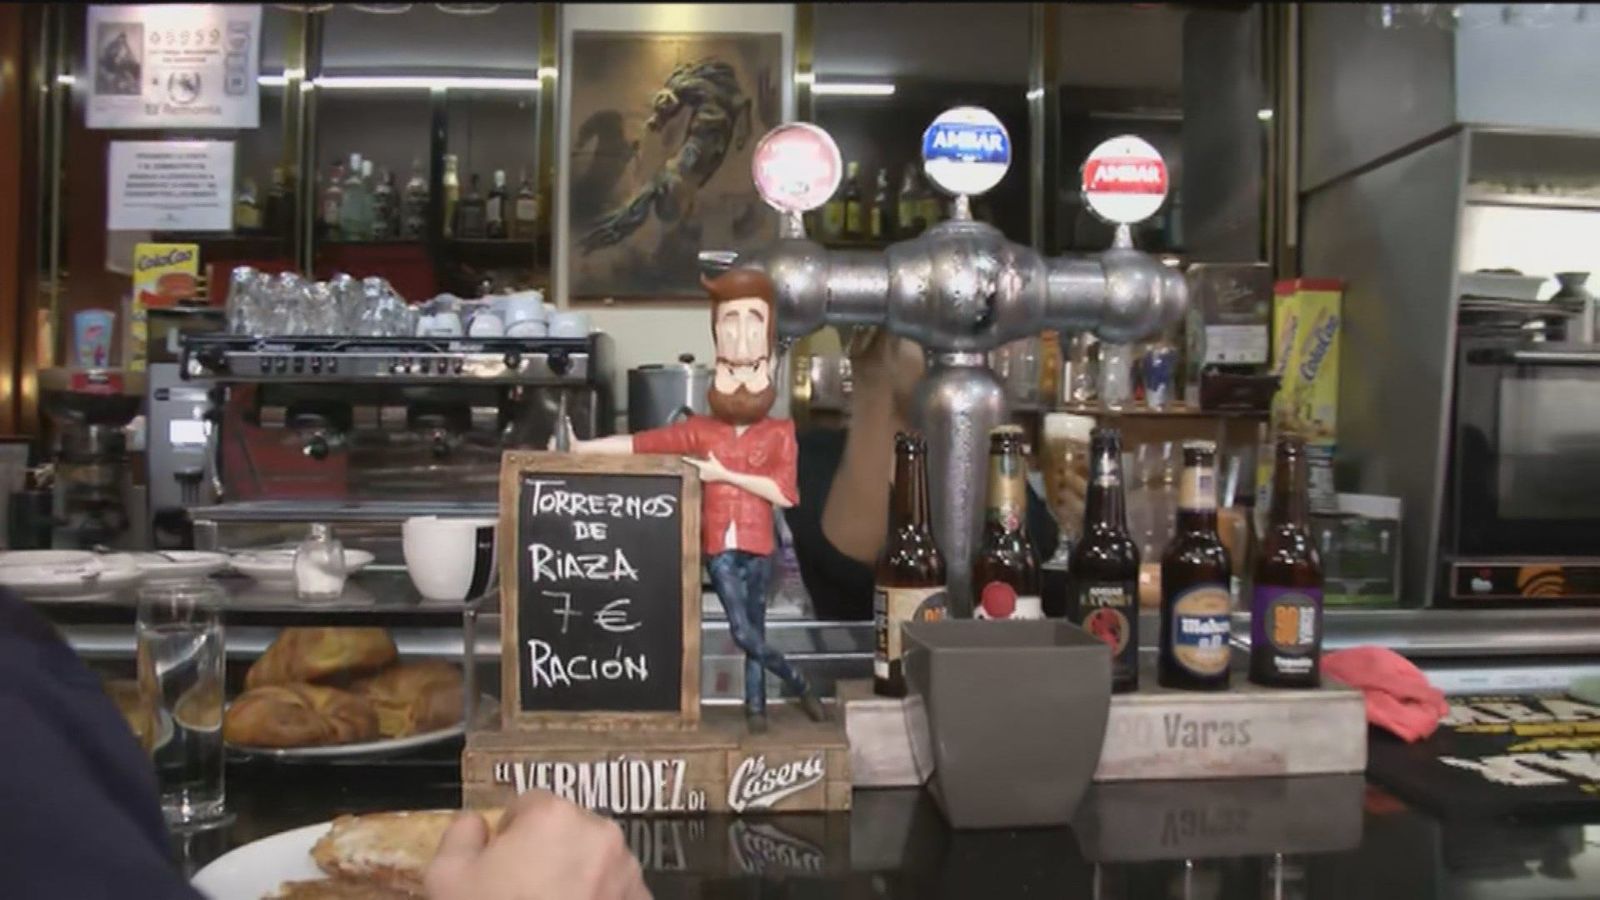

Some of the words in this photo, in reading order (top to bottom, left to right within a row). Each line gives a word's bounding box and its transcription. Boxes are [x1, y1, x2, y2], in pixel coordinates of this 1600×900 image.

[932, 129, 1005, 151] AMBAR
[1094, 164, 1161, 183] AMBAR
[525, 478, 677, 519] TORREZNOS
[573, 521, 608, 540] DE
[541, 590, 583, 634] 7
[593, 598, 643, 632] €
[527, 638, 649, 688] RACIÓN
[1163, 712, 1253, 748] Varas
